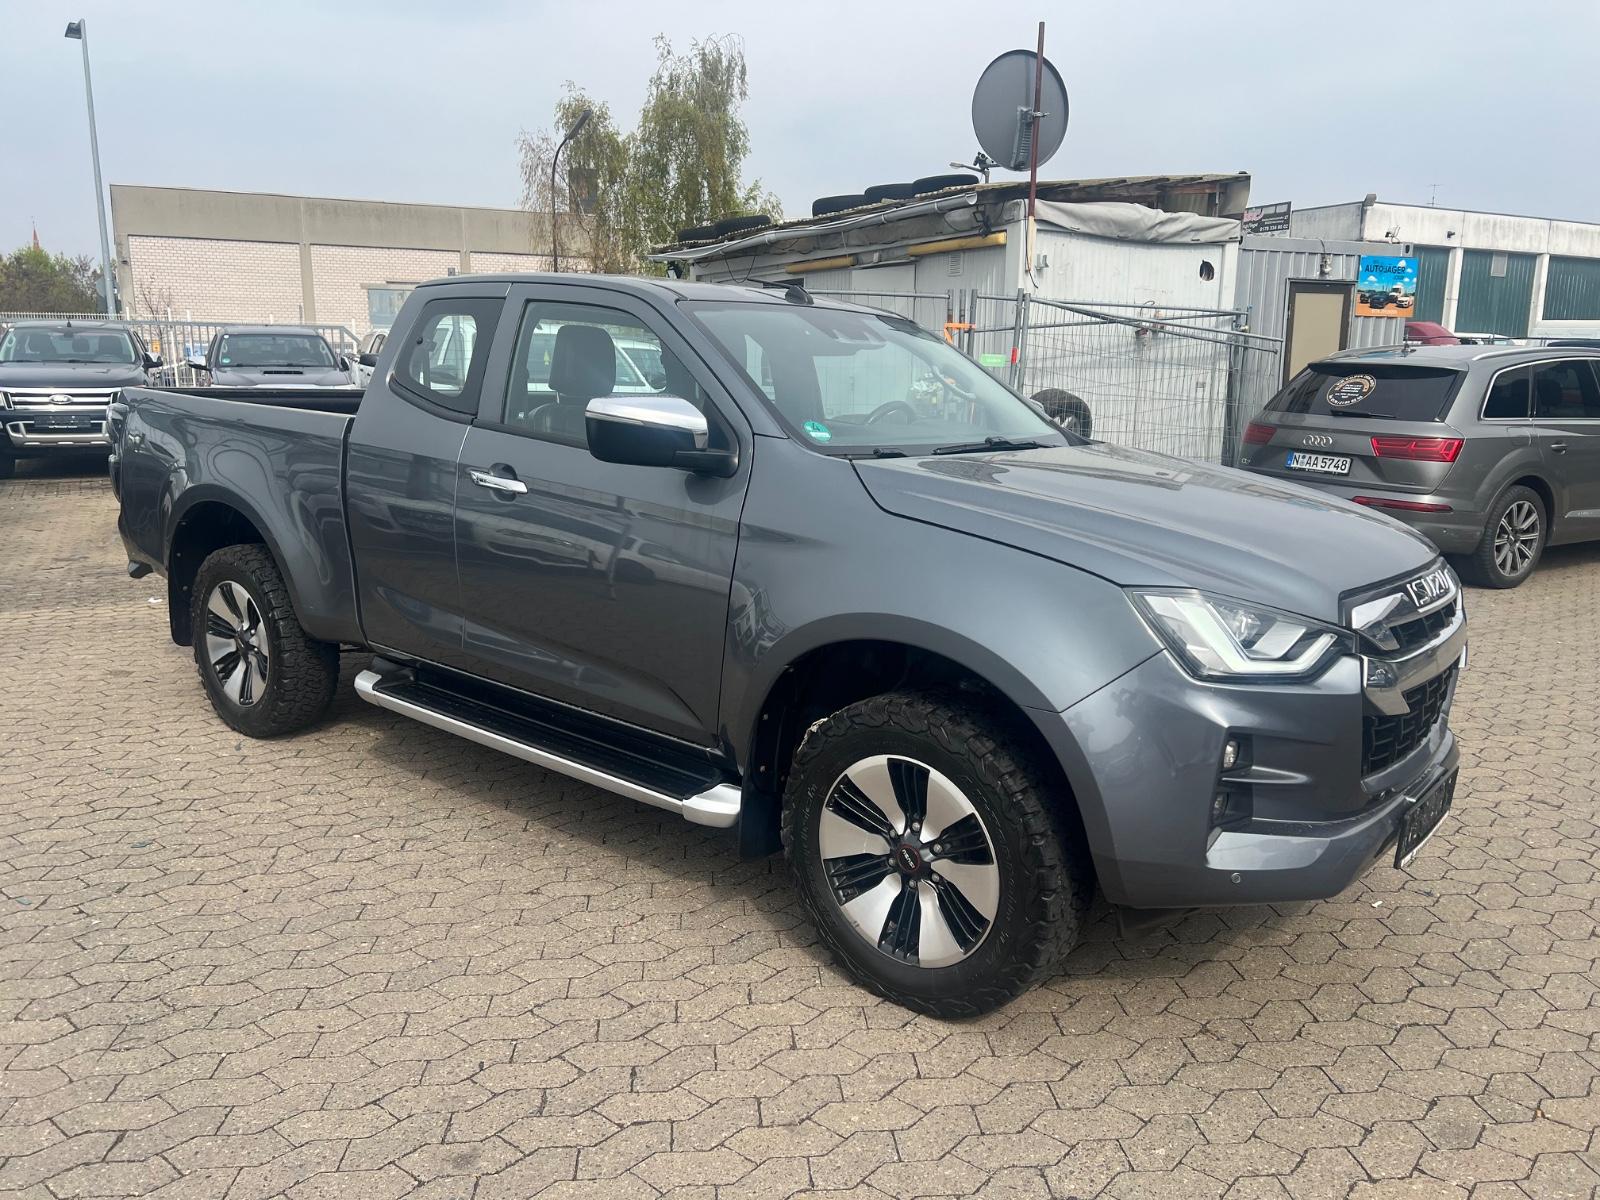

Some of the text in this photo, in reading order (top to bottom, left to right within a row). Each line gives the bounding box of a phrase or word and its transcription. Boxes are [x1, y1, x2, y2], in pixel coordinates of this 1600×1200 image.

[1292, 454, 1348, 472] N AA 5748
